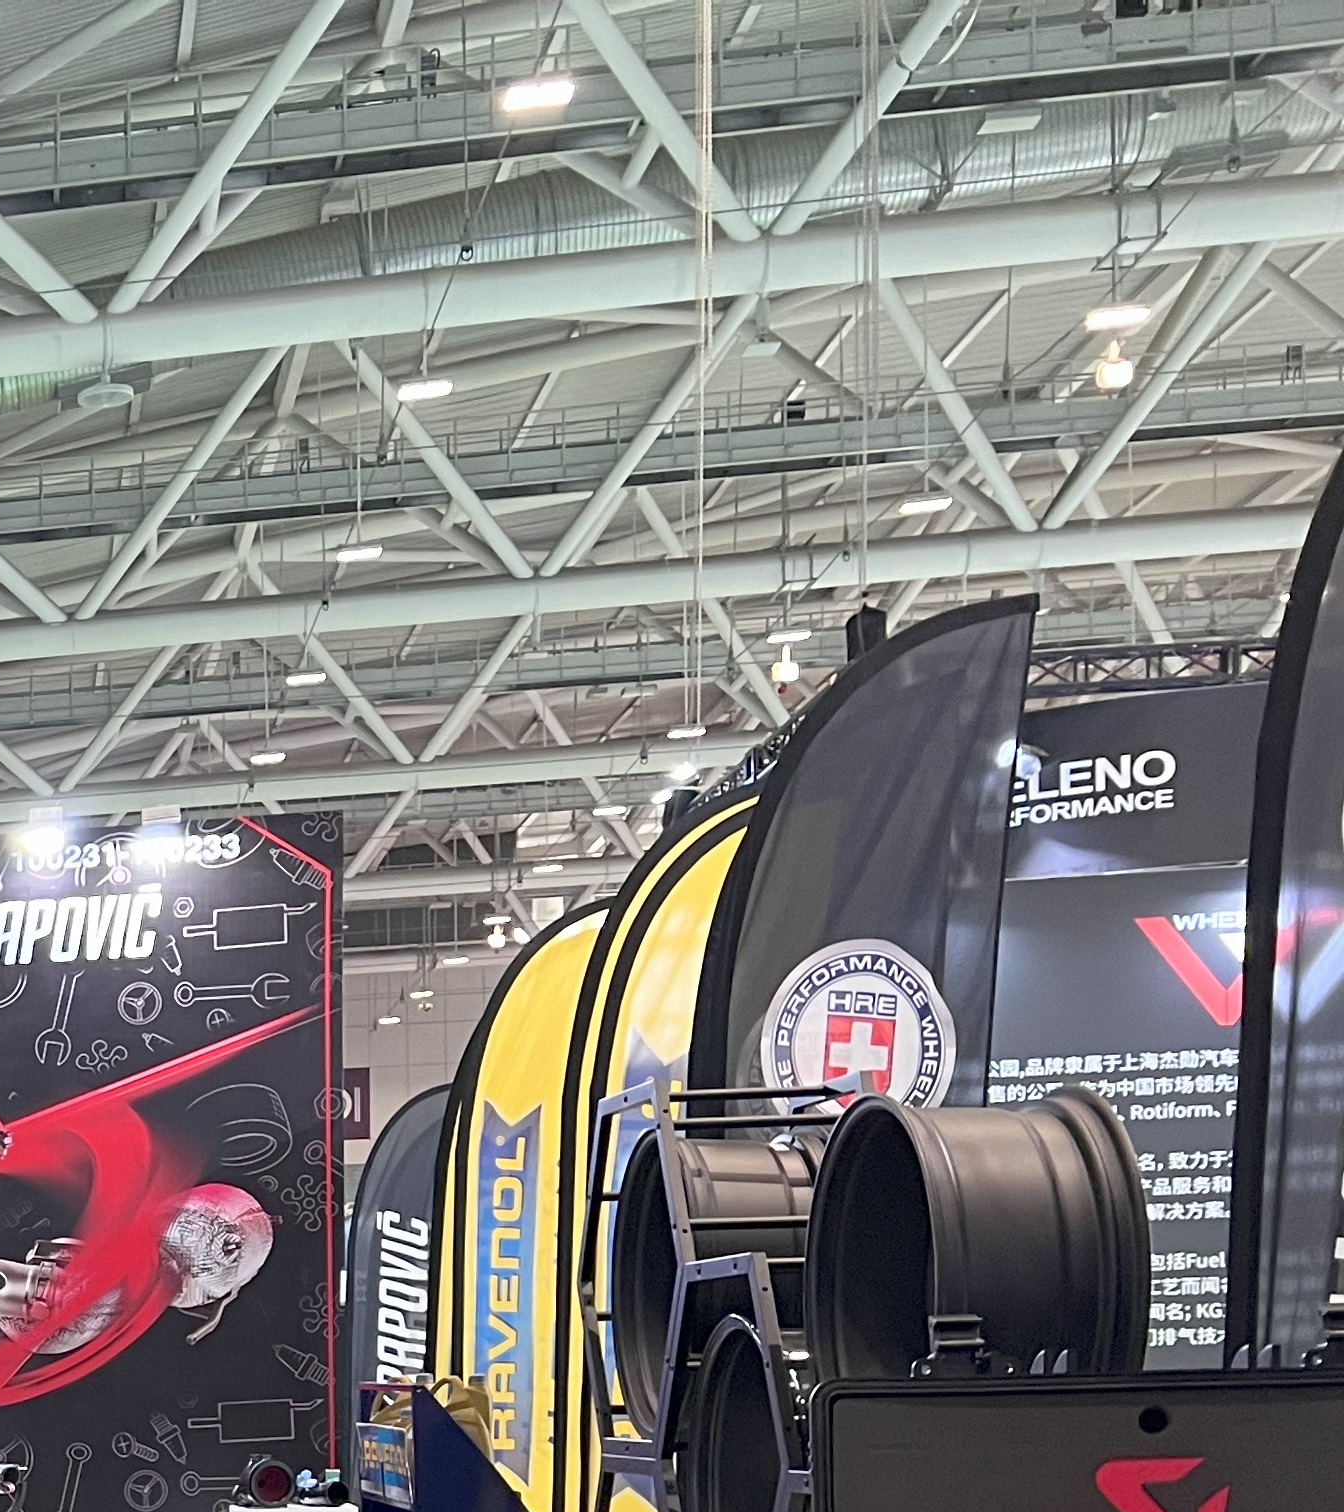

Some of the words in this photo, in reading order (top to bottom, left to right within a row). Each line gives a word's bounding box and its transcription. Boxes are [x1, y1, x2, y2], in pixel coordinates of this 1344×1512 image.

[777, 955, 929, 1046] PERFORMANCE
[904, 1014, 939, 1108] WHEEL
[829, 991, 897, 1015] HRE
[487, 1136, 526, 1450] RAVENOL
